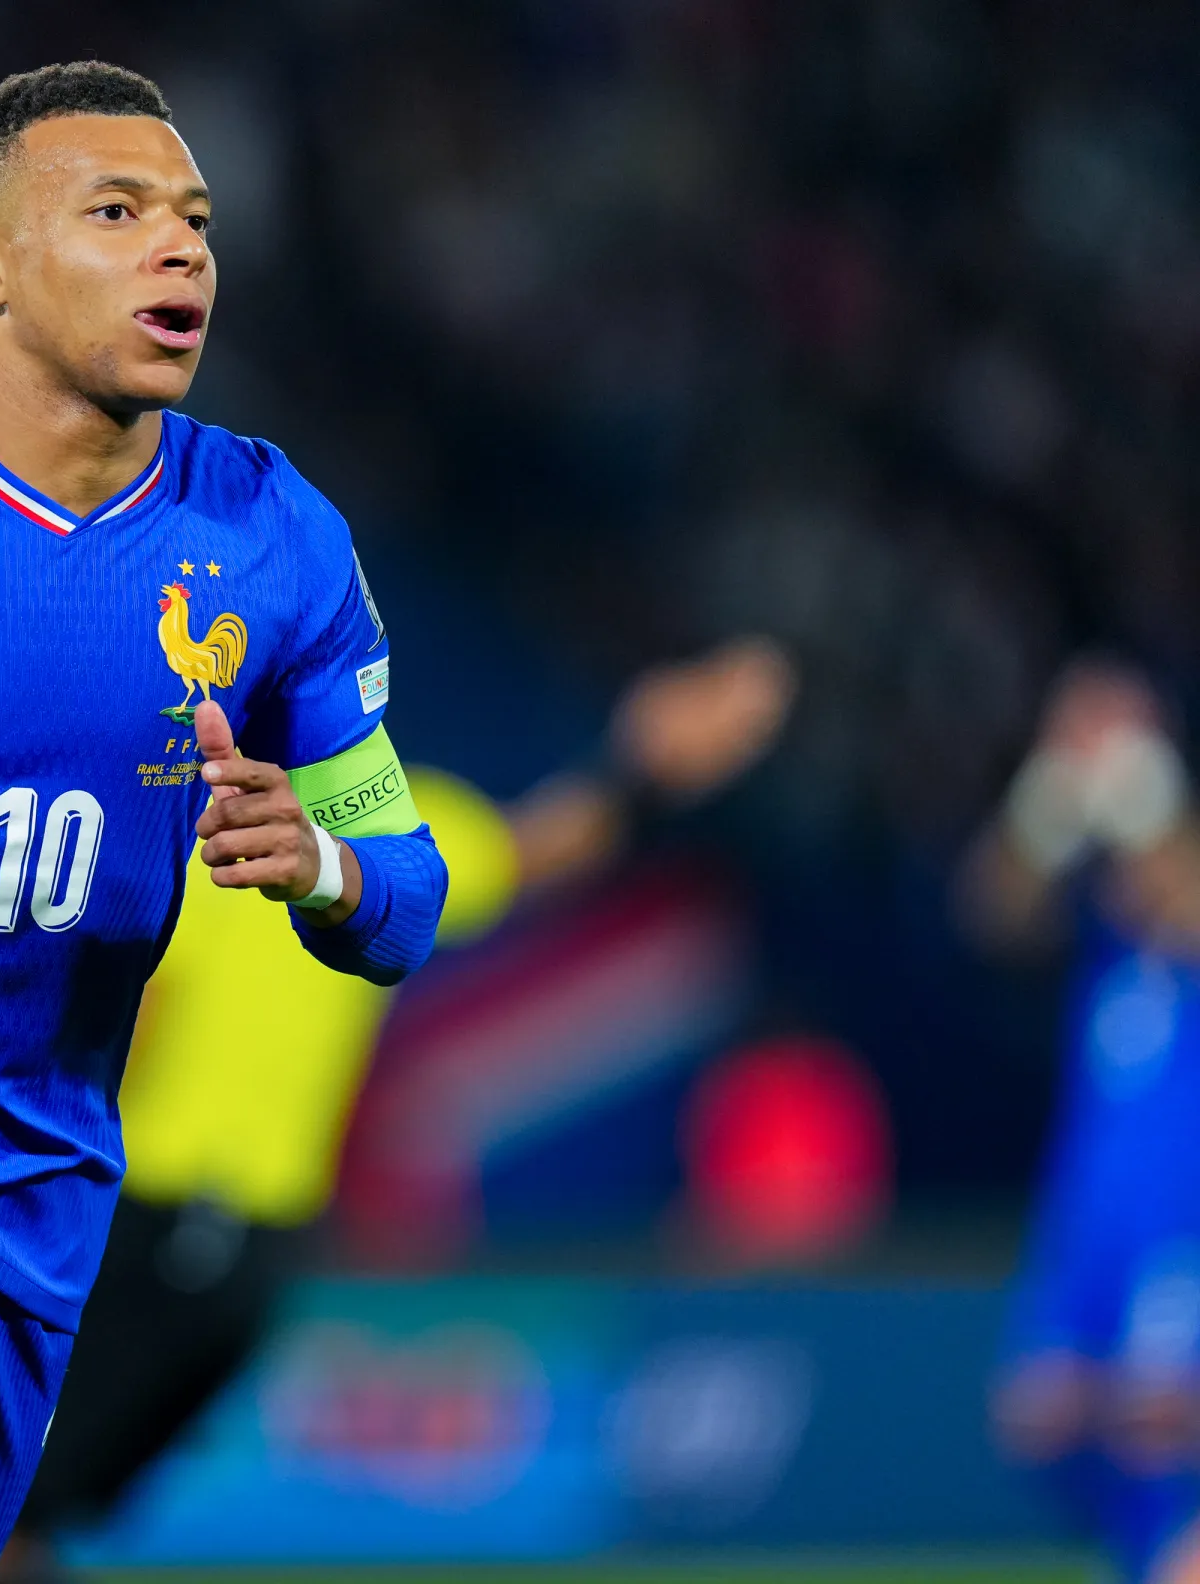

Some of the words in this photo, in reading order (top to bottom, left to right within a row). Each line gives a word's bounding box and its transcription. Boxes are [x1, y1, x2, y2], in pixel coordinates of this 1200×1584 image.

[137, 763, 165, 774] FRANCE
[142, 775, 152, 786] 10
[312, 769, 400, 827] RESPECT
